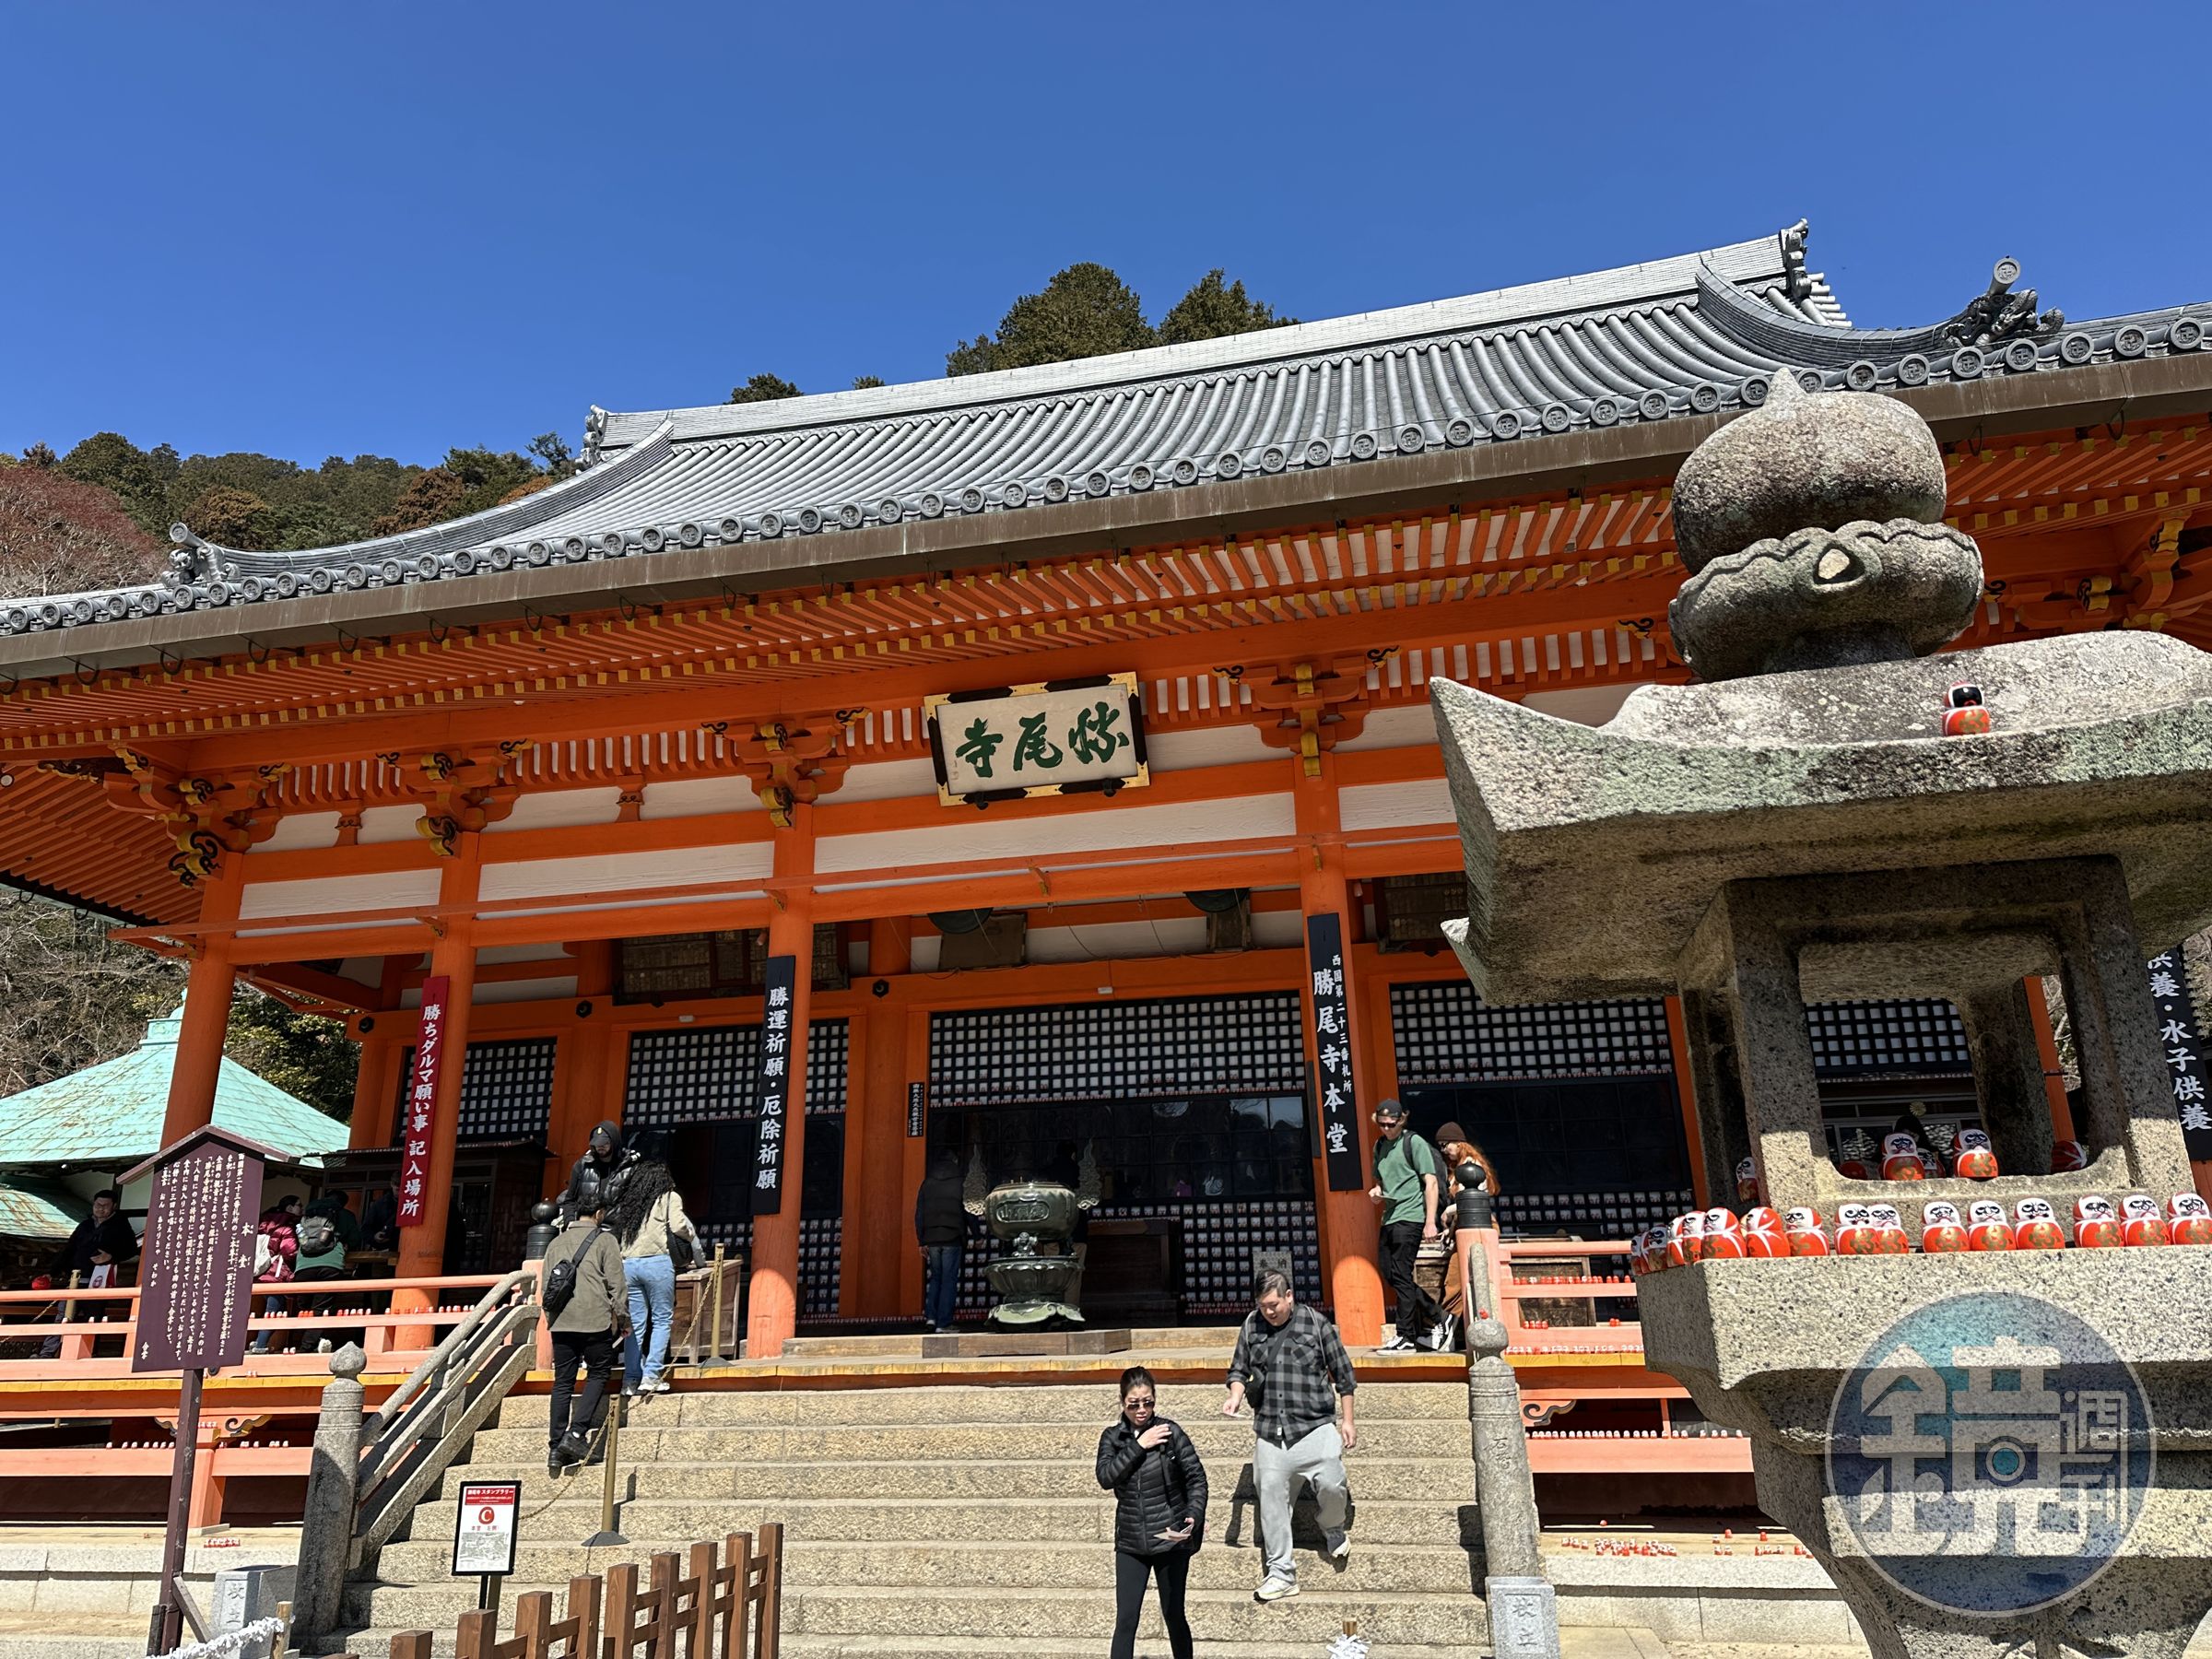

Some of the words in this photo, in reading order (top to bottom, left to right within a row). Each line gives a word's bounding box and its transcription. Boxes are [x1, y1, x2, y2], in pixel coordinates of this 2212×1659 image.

[412, 1004, 441, 1133] 勝ちダルマ願い事
[756, 986, 789, 1190] 勝運祈願・厄除祈願
[1312, 968, 1348, 1153] 勝尾寺本堂
[1332, 954, 1352, 1093] 西国第二十三番札所
[238, 1221, 252, 1269] 本堂
[400, 1139, 427, 1218] 記入場所
